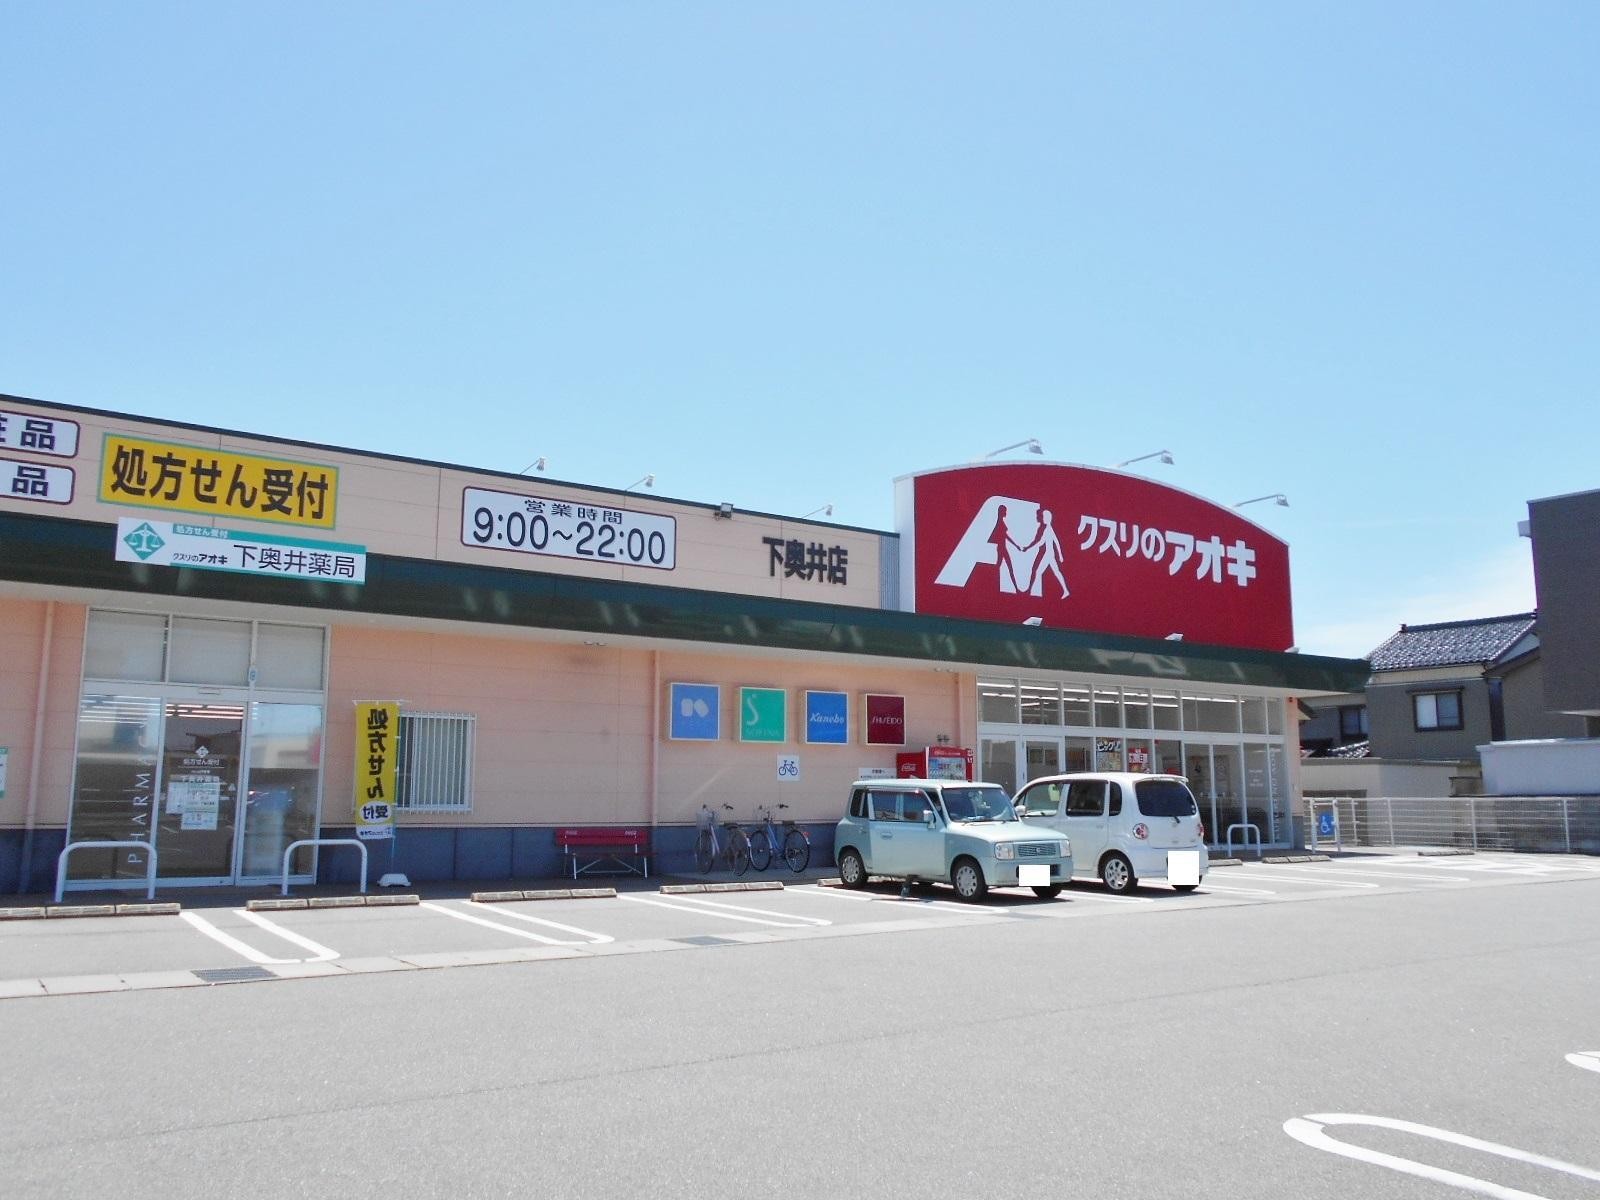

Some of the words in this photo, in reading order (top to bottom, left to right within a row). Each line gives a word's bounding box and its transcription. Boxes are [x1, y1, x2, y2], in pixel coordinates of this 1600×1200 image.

[111, 444, 329, 520] 処方せん受付
[524, 499, 623, 525] 営業時間
[176, 524, 228, 539] 処方せん受付
[173, 552, 228, 565] クスリのアオキ
[233, 544, 355, 578] 下奥井薬局
[762, 536, 848, 585] 下奥井店
[1077, 515, 1257, 587] クスリのアオキ
[809, 712, 845, 724] Kanebo
[871, 715, 903, 725] SHISEIDO
